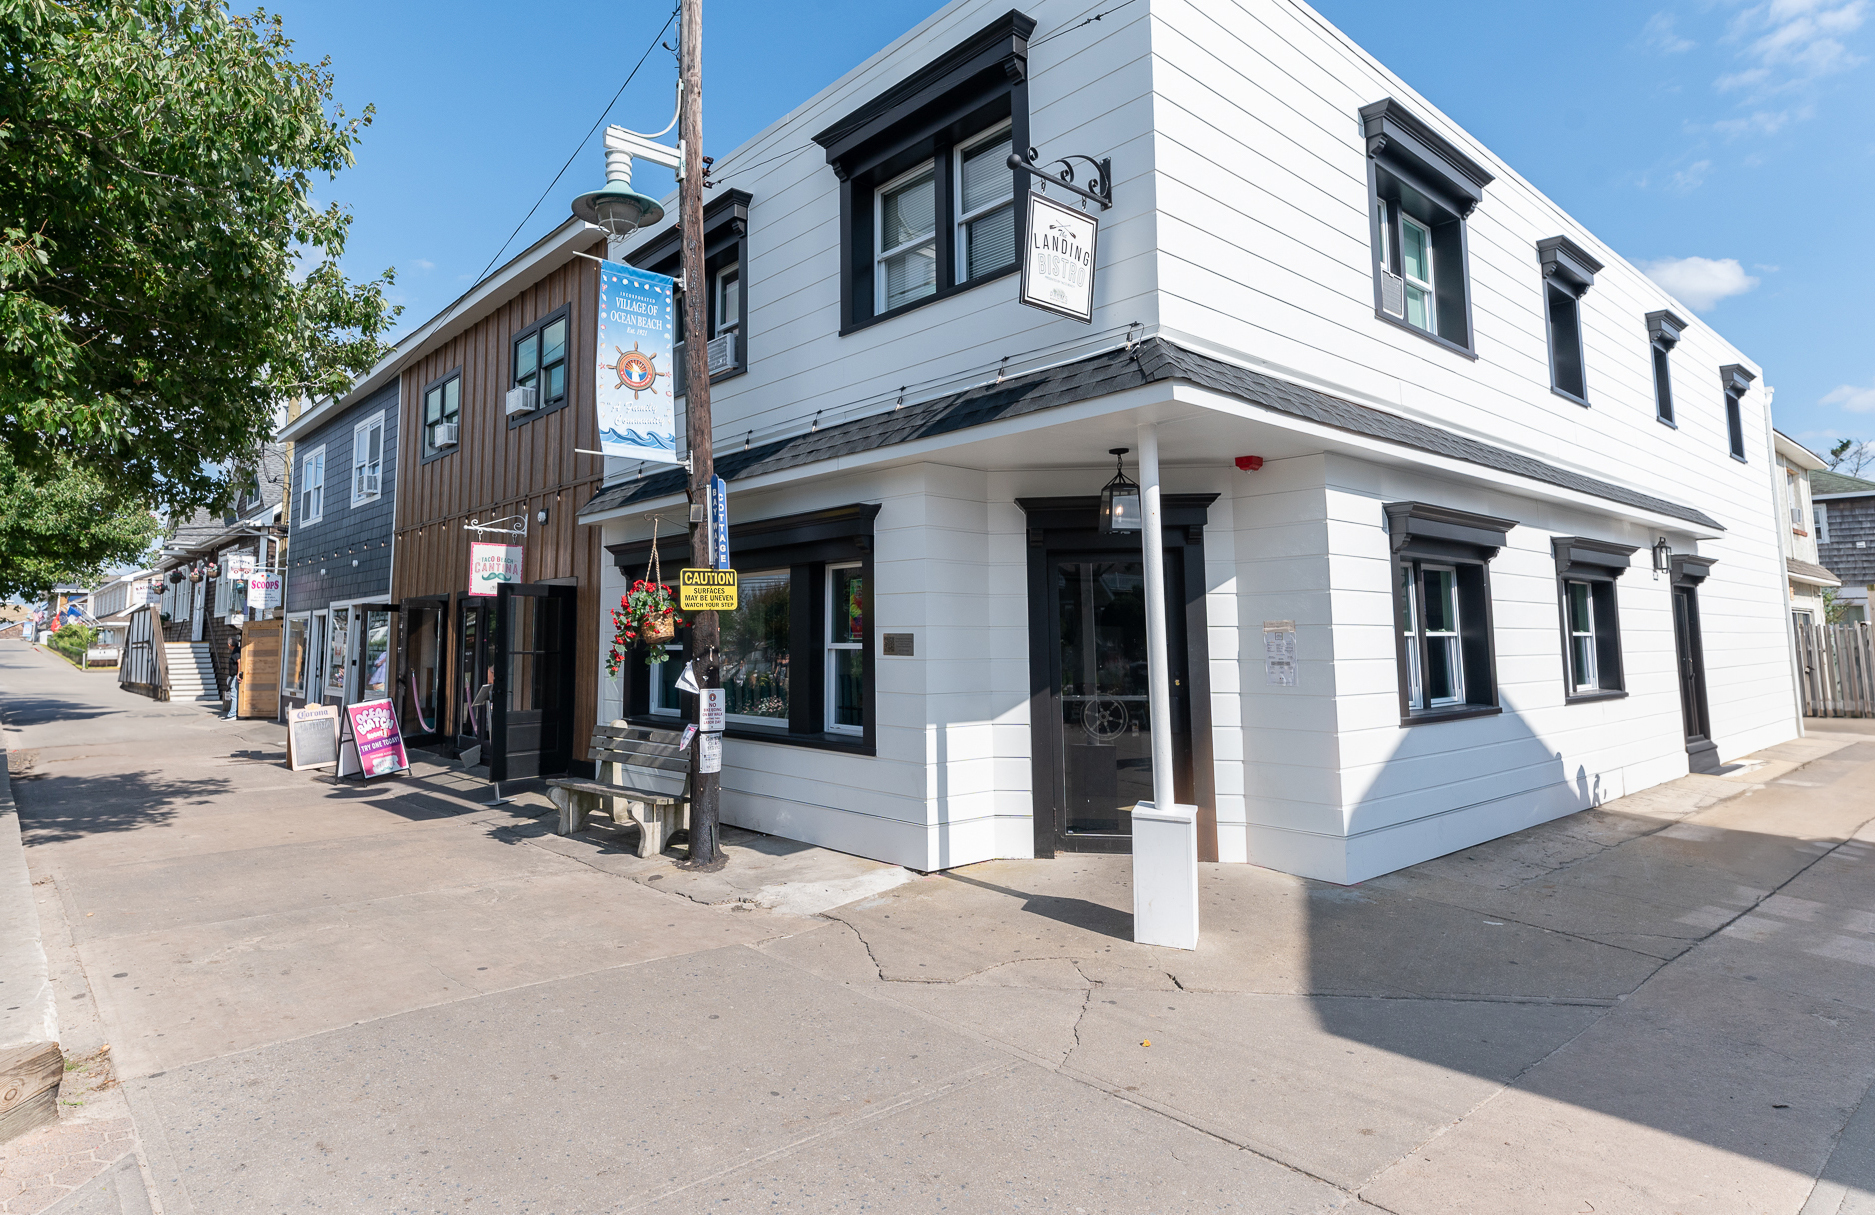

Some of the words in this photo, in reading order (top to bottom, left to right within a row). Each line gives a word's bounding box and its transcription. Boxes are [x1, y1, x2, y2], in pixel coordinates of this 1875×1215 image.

[1034, 233, 1090, 266] LANDING
[1038, 253, 1085, 287] BISTRO
[620, 292, 655, 303] INCORPORATED
[616, 297, 647, 314] VILLAGE
[648, 305, 658, 316] OF
[610, 310, 636, 325] OCEAN
[638, 316, 662, 330] BEACH
[637, 329, 648, 337] 1921
[624, 401, 658, 415] Family
[718, 493, 726, 562] COTTAGE
[497, 556, 514, 564] BEACH
[475, 562, 518, 575] CANTINA
[251, 580, 280, 590] SCOOPS
[684, 572, 734, 585] CAUTION
[684, 594, 699, 602] MAY
[700, 594, 709, 602] BE
[710, 594, 734, 602] UNEVEN
[297, 709, 329, 720] Corona
[356, 708, 390, 724] OCEAN
[361, 744, 370, 752] TRY
[372, 741, 382, 749] ONE
